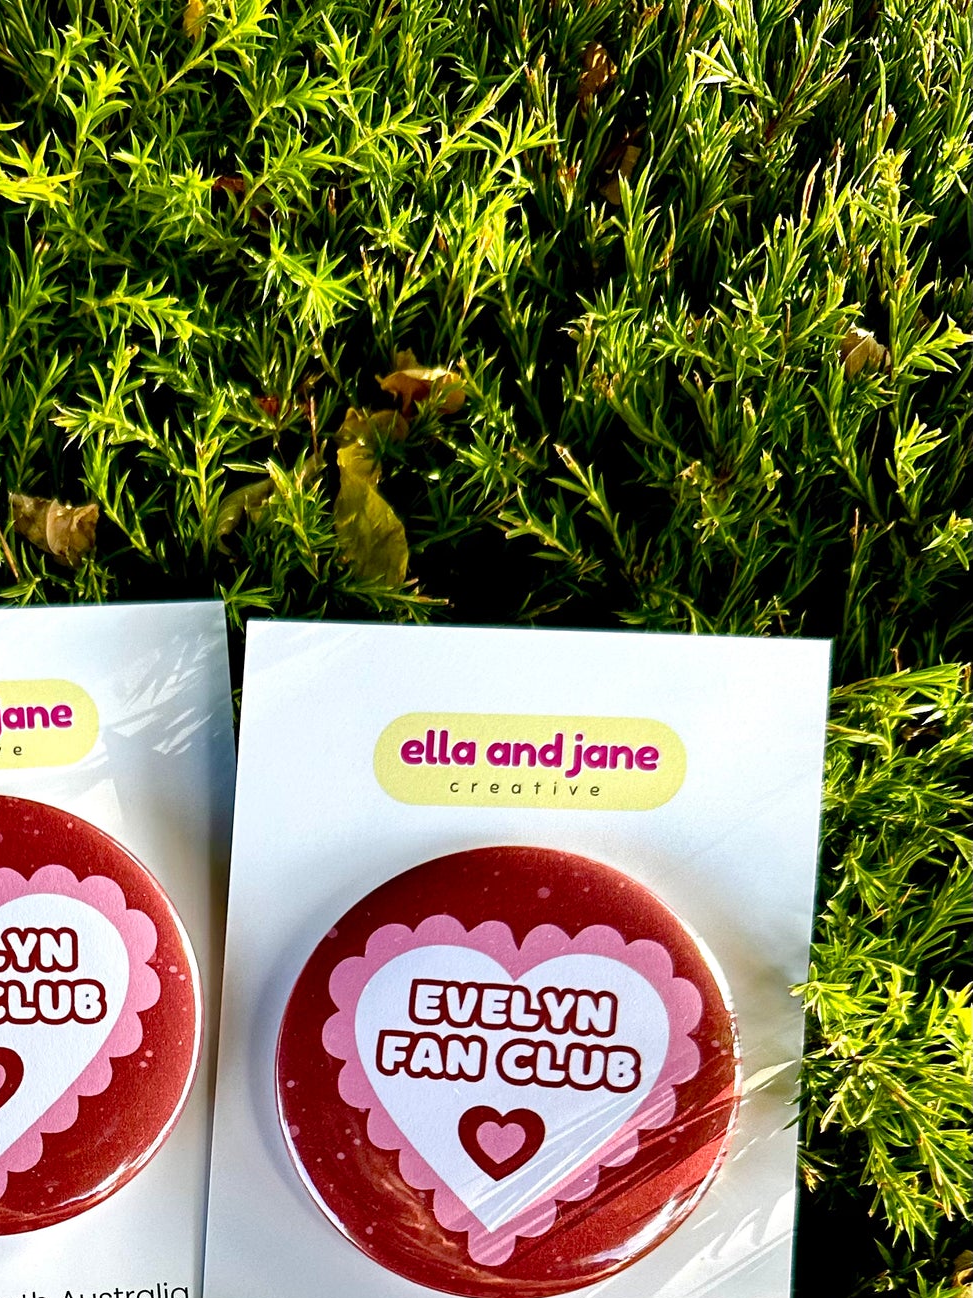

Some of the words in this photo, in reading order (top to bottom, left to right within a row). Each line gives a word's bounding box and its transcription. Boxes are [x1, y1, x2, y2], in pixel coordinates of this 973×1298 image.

[399, 728, 478, 766] ella
[485, 732, 565, 769] and
[564, 733, 661, 779] jane
[448, 780, 602, 798] creative
[408, 978, 618, 1038] EVELYN
[375, 1029, 488, 1083] FAN
[495, 1038, 641, 1094] CLUB
